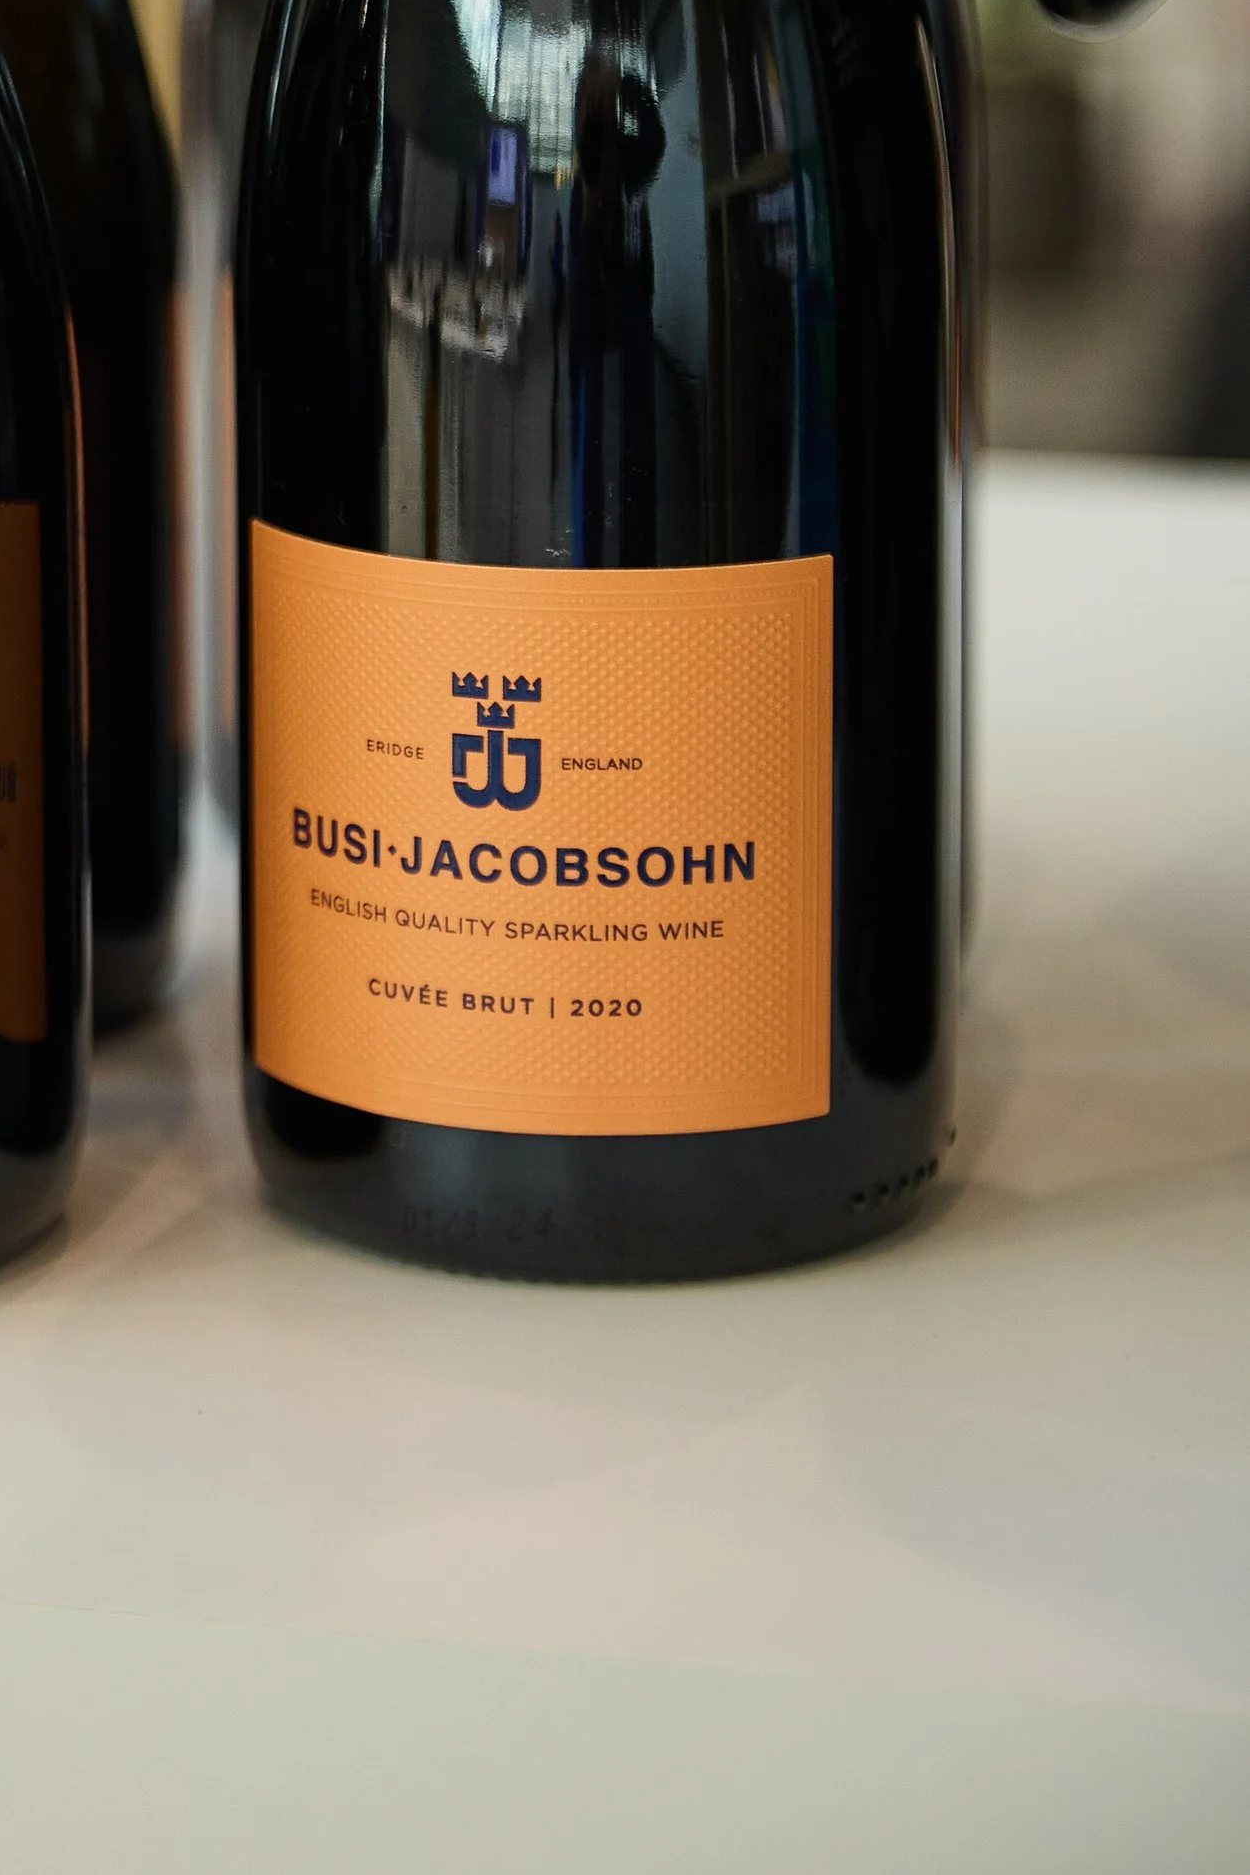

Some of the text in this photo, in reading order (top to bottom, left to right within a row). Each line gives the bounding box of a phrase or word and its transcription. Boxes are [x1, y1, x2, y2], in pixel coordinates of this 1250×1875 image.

[366, 738, 644, 772] ERIDGE ENGLAND
[310, 888, 725, 943] ENGLISH QUALITY SPARKLING WINE
[367, 978, 448, 1008] CUVÉE
[462, 993, 535, 1015] BRUT
[570, 998, 643, 1018] 2020
